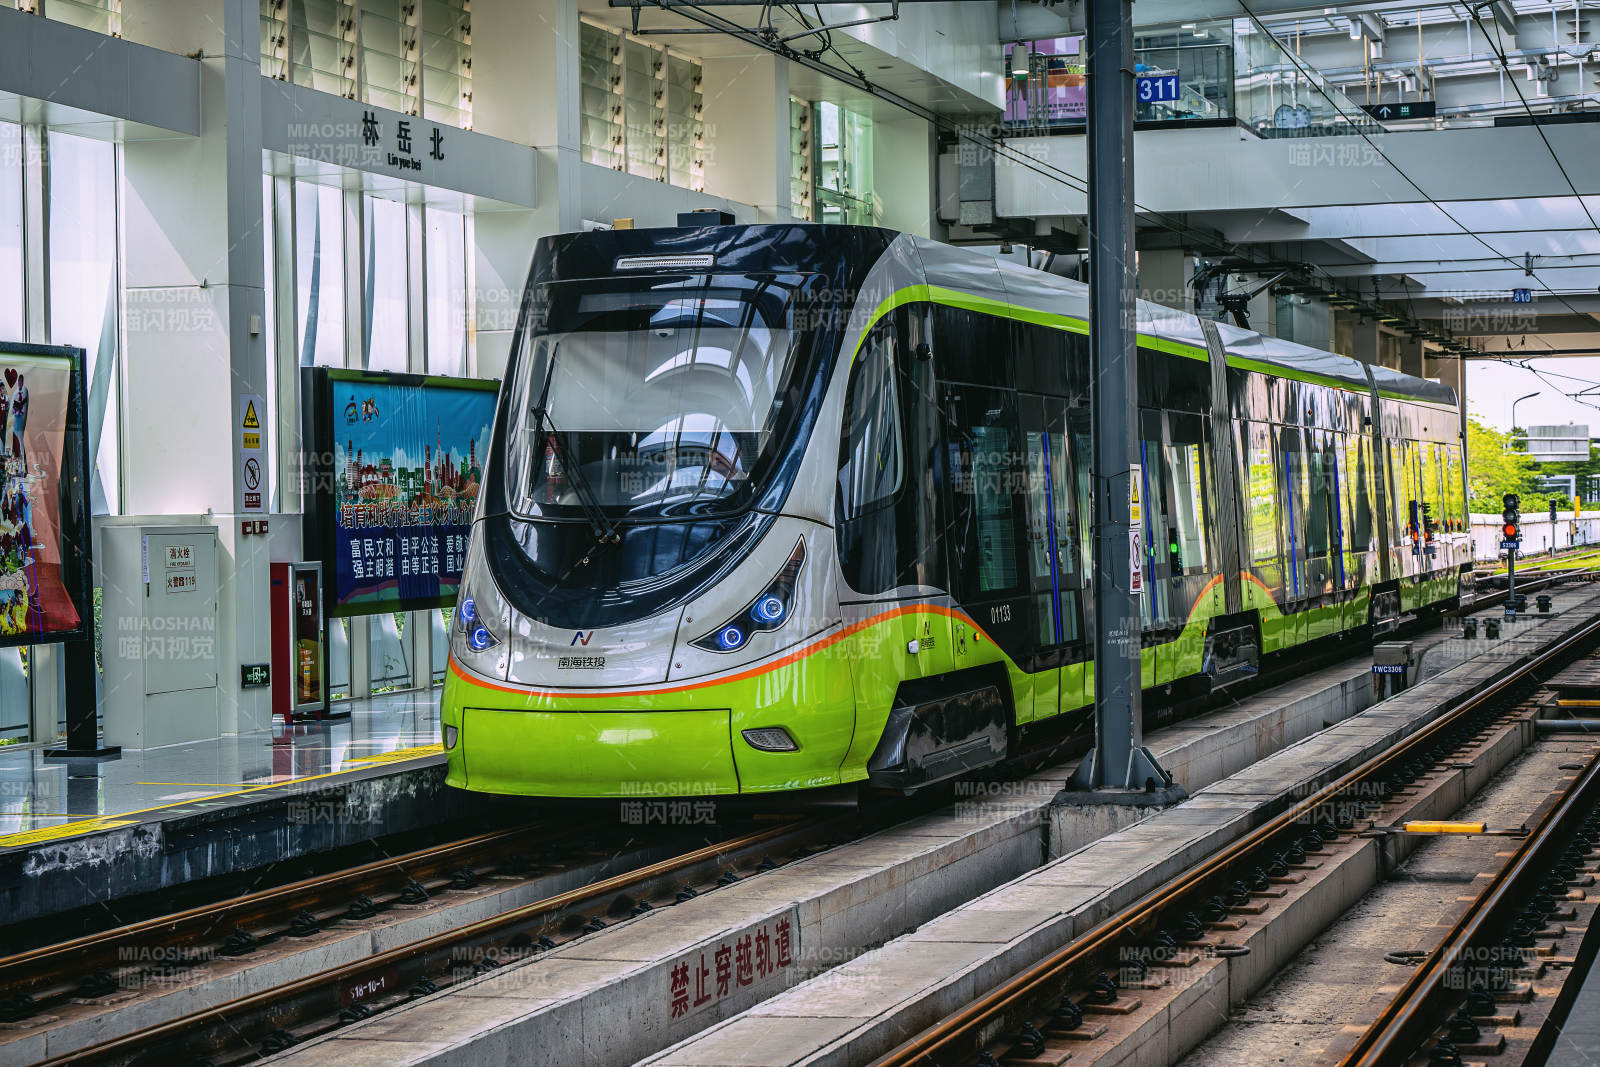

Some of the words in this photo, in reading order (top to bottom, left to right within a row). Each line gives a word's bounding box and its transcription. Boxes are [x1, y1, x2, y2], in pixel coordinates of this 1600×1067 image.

[1140, 78, 1176, 100] 311
[362, 111, 444, 160] 林岳北
[388, 153, 398, 165] Lin
[399, 158, 410, 170] yue
[411, 158, 421, 170] bei
[1514, 293, 1531, 303] 310
[170, 547, 190, 559] 消火栓
[558, 657, 605, 667] 南海铁投
[671, 917, 791, 1019] 禁止穿越轨道
